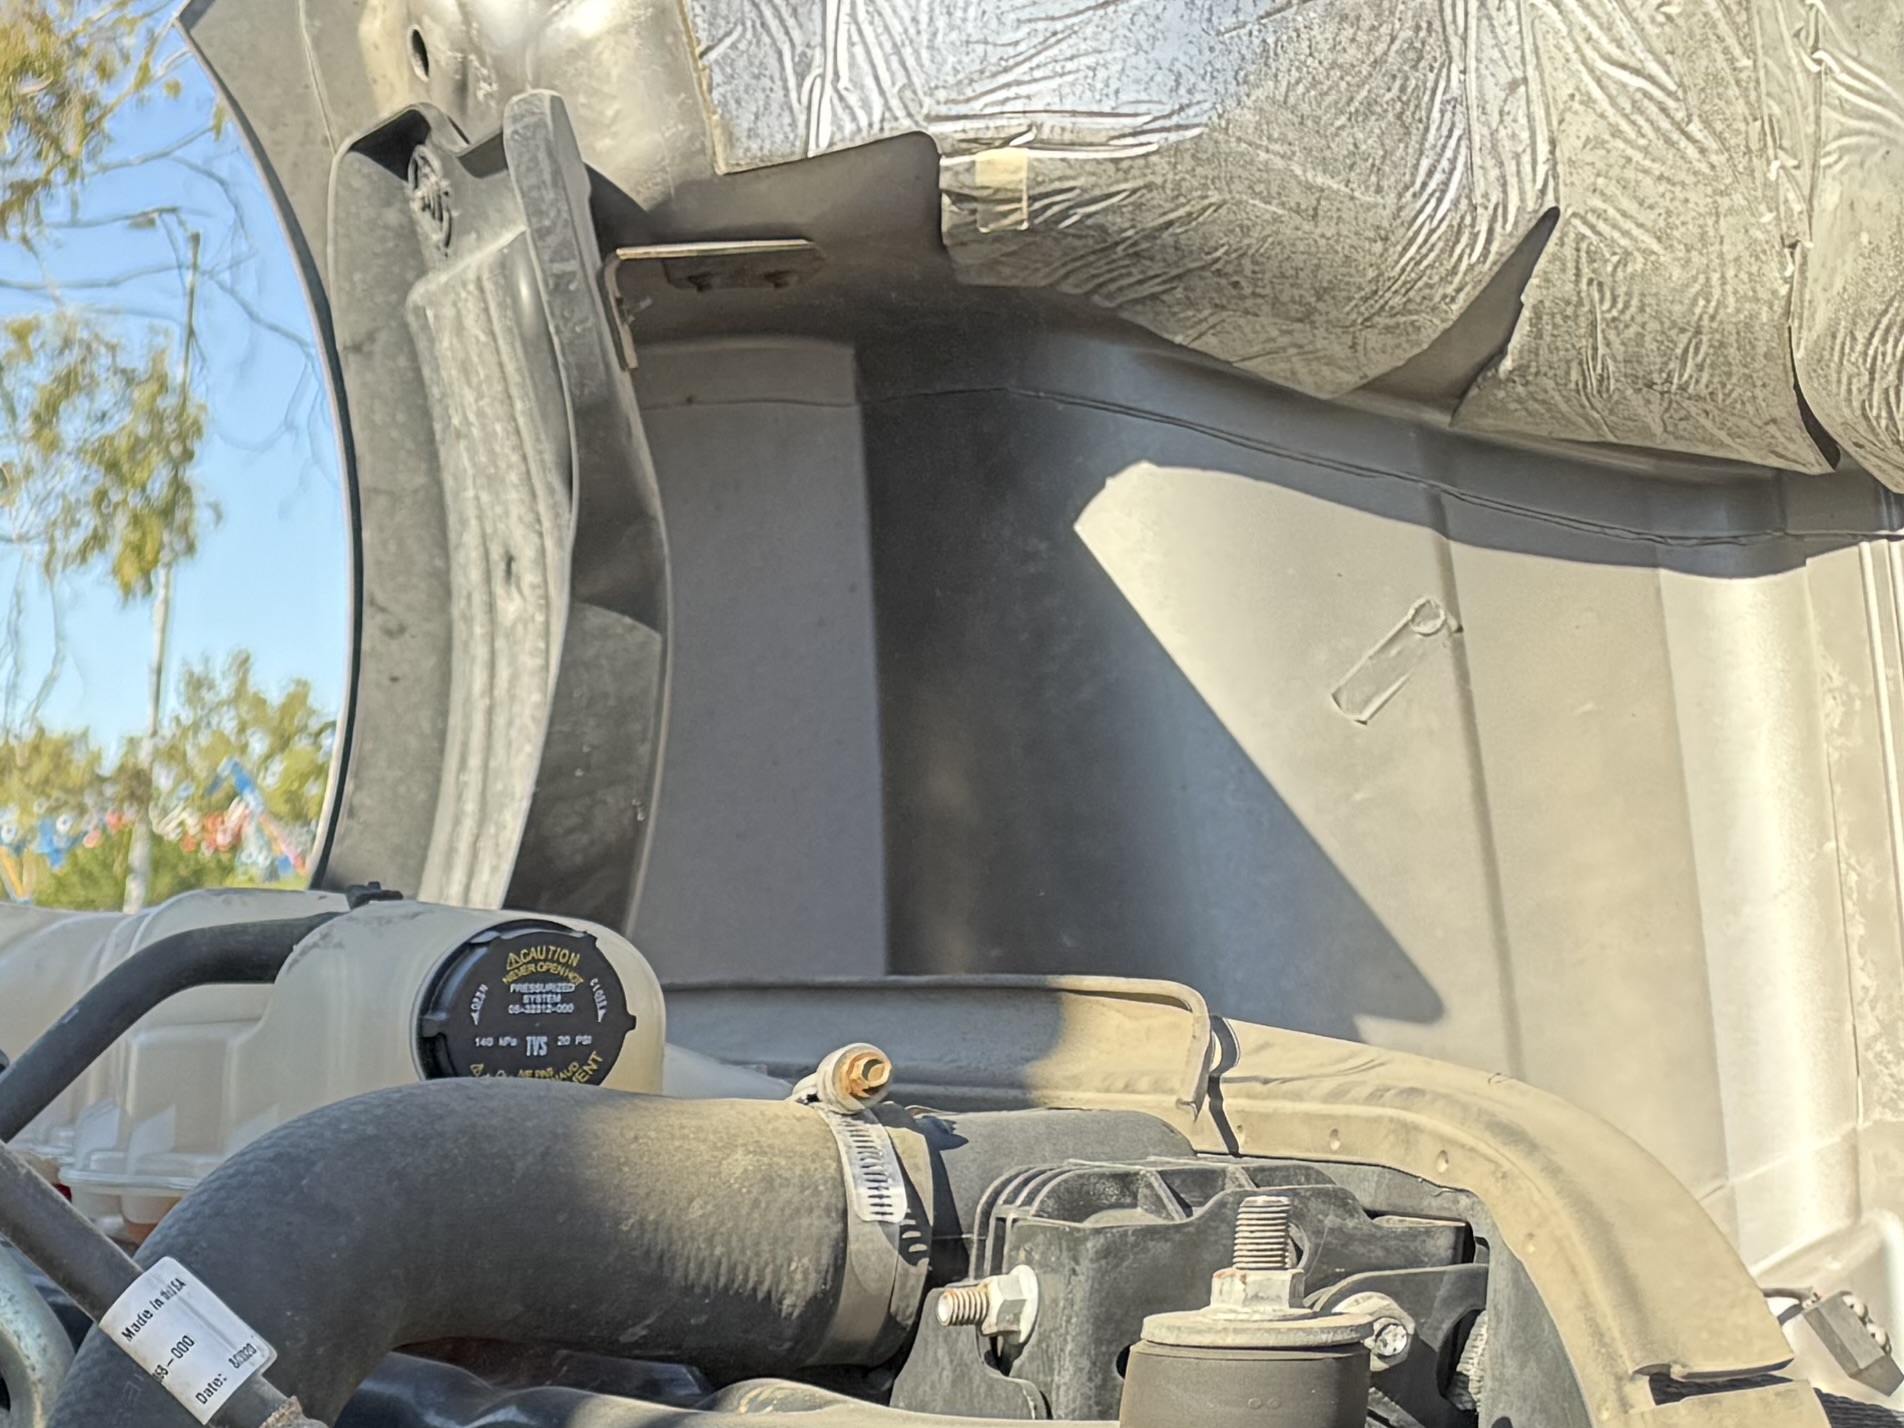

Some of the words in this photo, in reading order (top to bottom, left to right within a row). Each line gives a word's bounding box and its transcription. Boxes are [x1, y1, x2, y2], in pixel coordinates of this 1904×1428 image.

[520, 945, 580, 967] CAUTION
[510, 983, 575, 993] PRESSURIZED
[522, 994, 561, 1003] SYSTEM
[526, 1036, 548, 1056] TVS
[121, 1308, 153, 1342] Made
[195, 1373, 228, 1405] Date:
